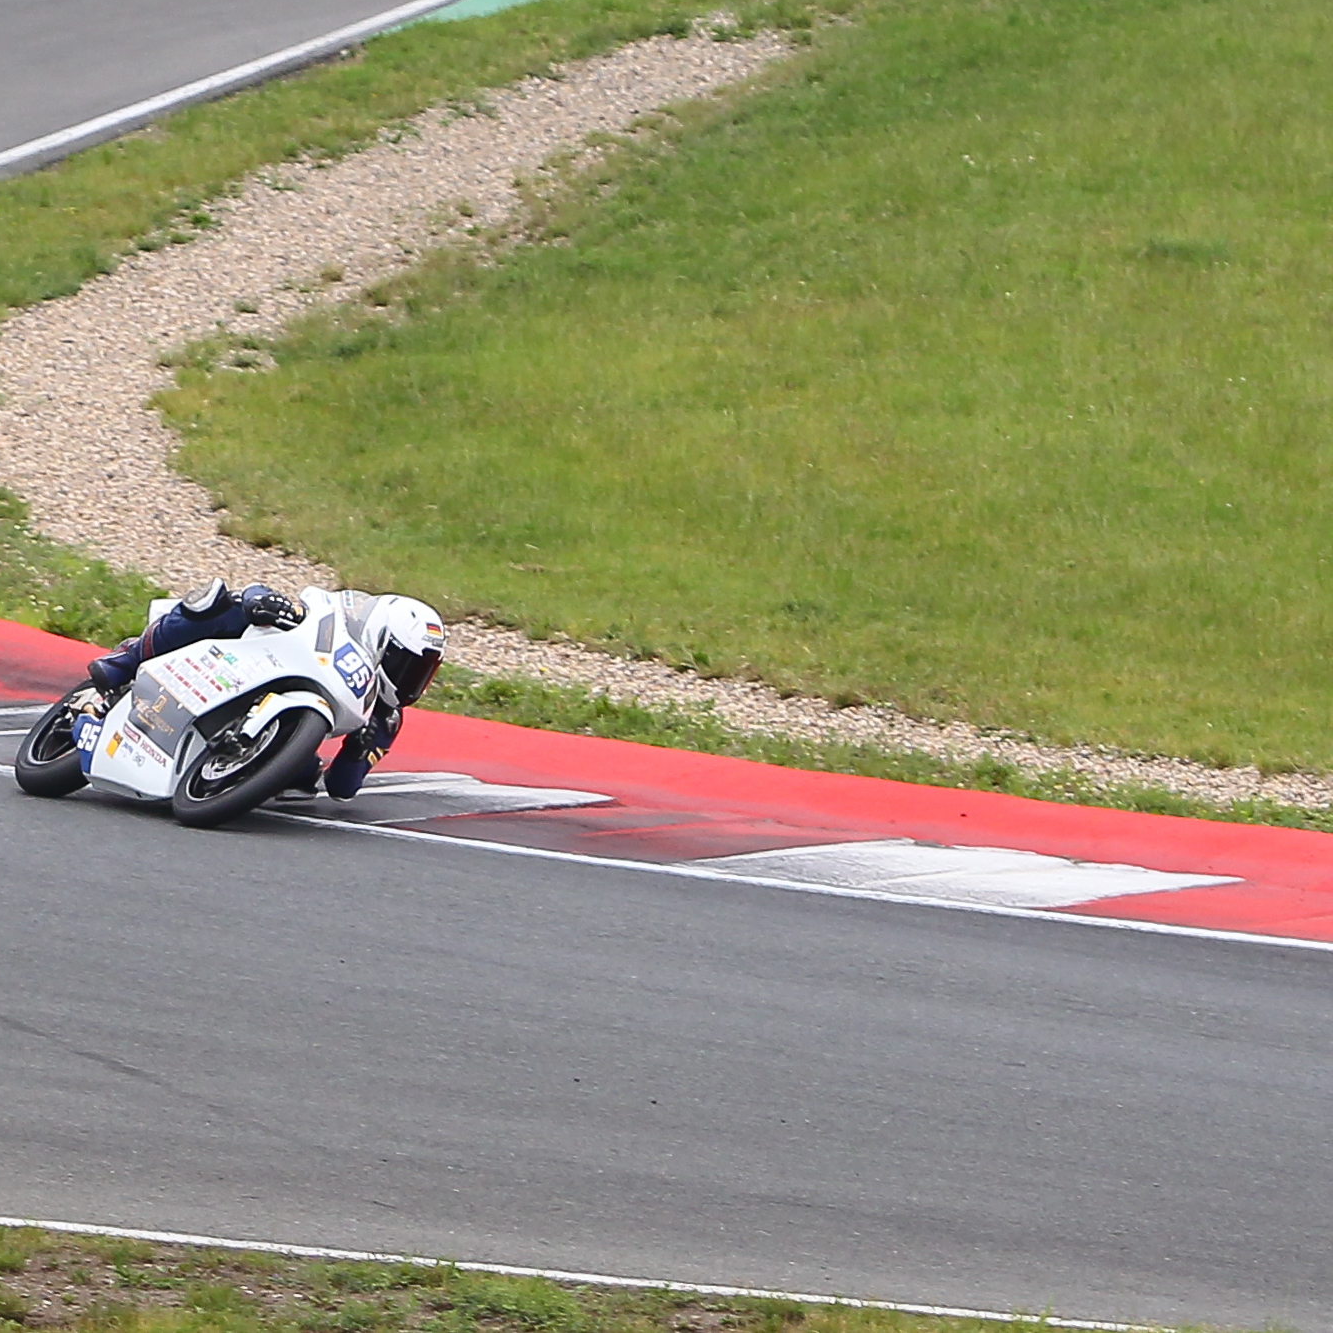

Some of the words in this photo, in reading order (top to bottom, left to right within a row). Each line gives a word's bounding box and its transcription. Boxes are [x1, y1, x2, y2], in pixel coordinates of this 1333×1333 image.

[336, 651, 371, 689] 95
[76, 722, 102, 751] 95
[139, 739, 167, 767] HONDA
